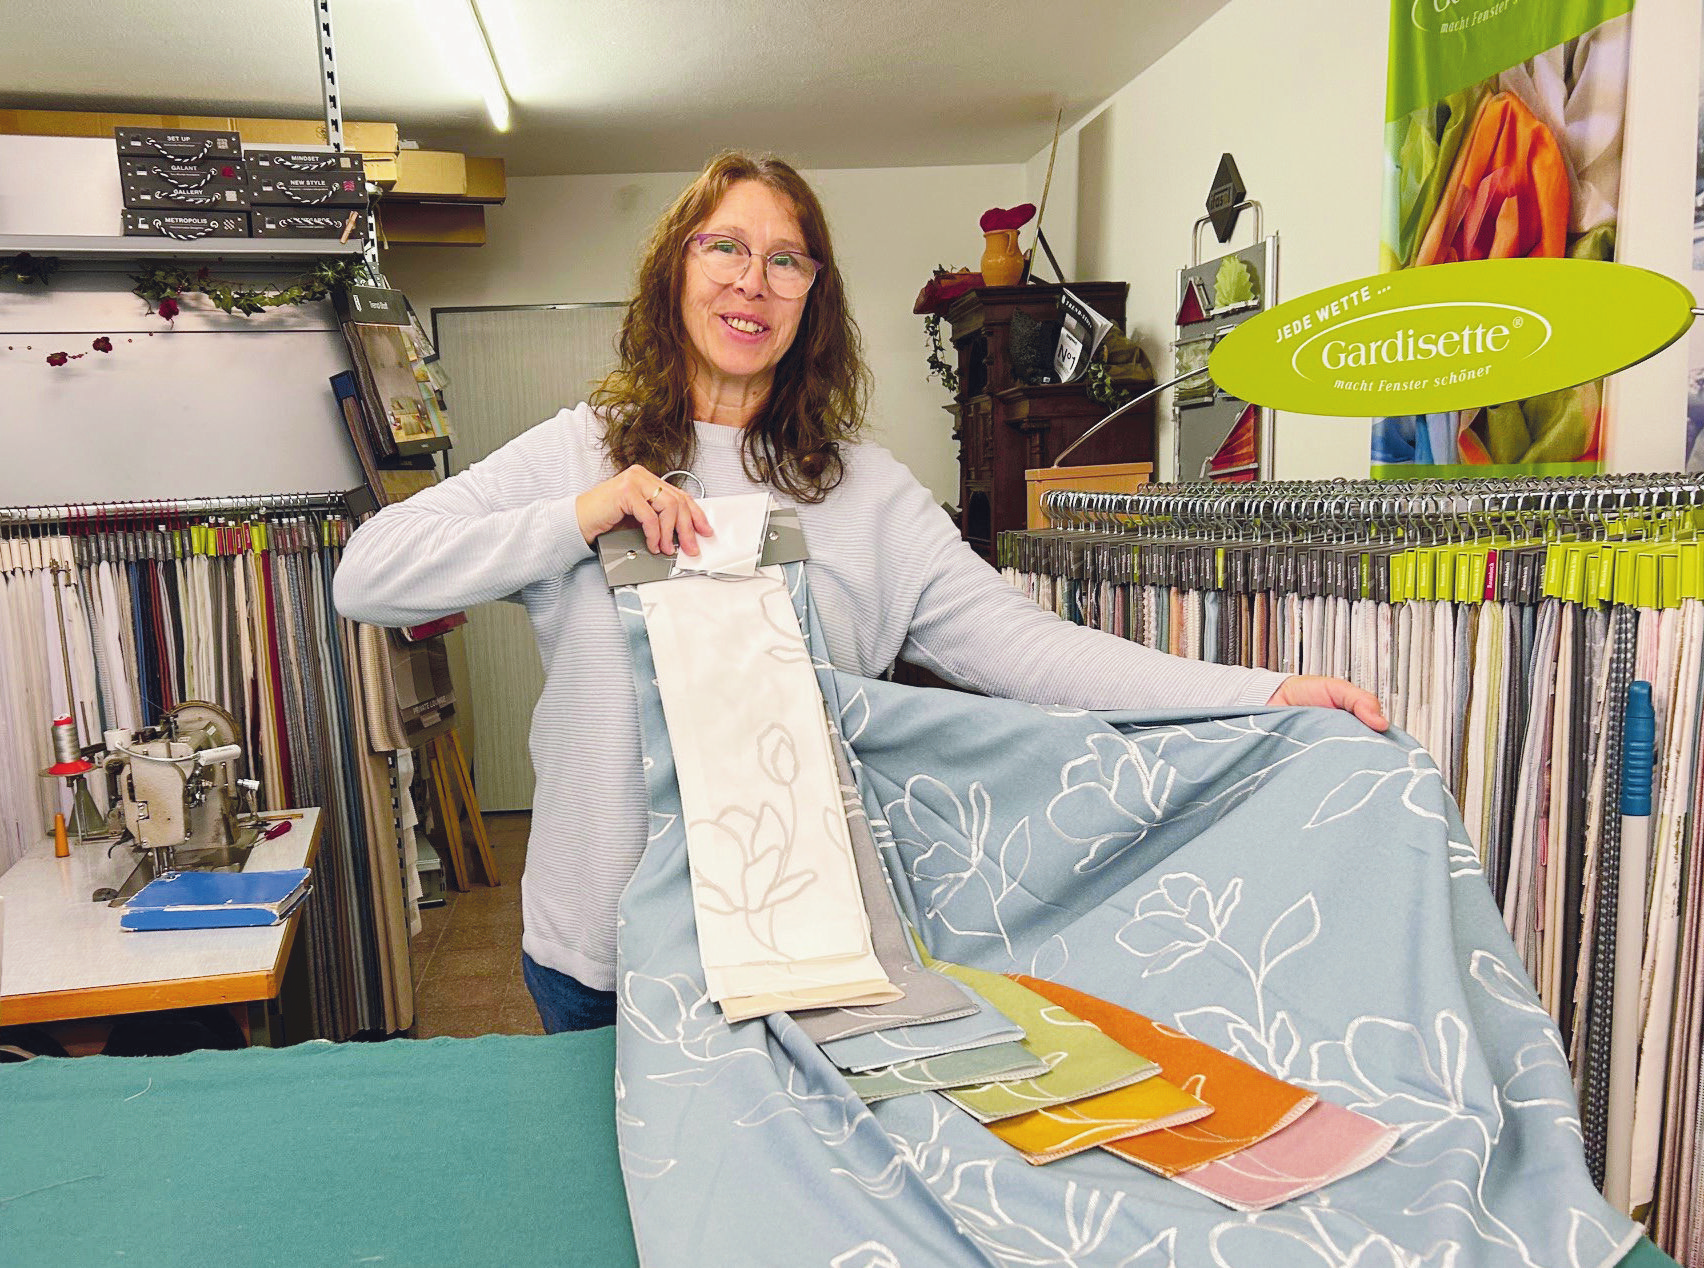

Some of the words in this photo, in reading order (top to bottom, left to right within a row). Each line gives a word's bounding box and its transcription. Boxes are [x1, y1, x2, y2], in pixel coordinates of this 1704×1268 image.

[1275, 314, 1313, 343] JEDE
[1315, 285, 1372, 323] WETTE
[1333, 378, 1374, 392] macht
[1378, 378, 1428, 392] Fenster
[1434, 364, 1492, 387] schöner
